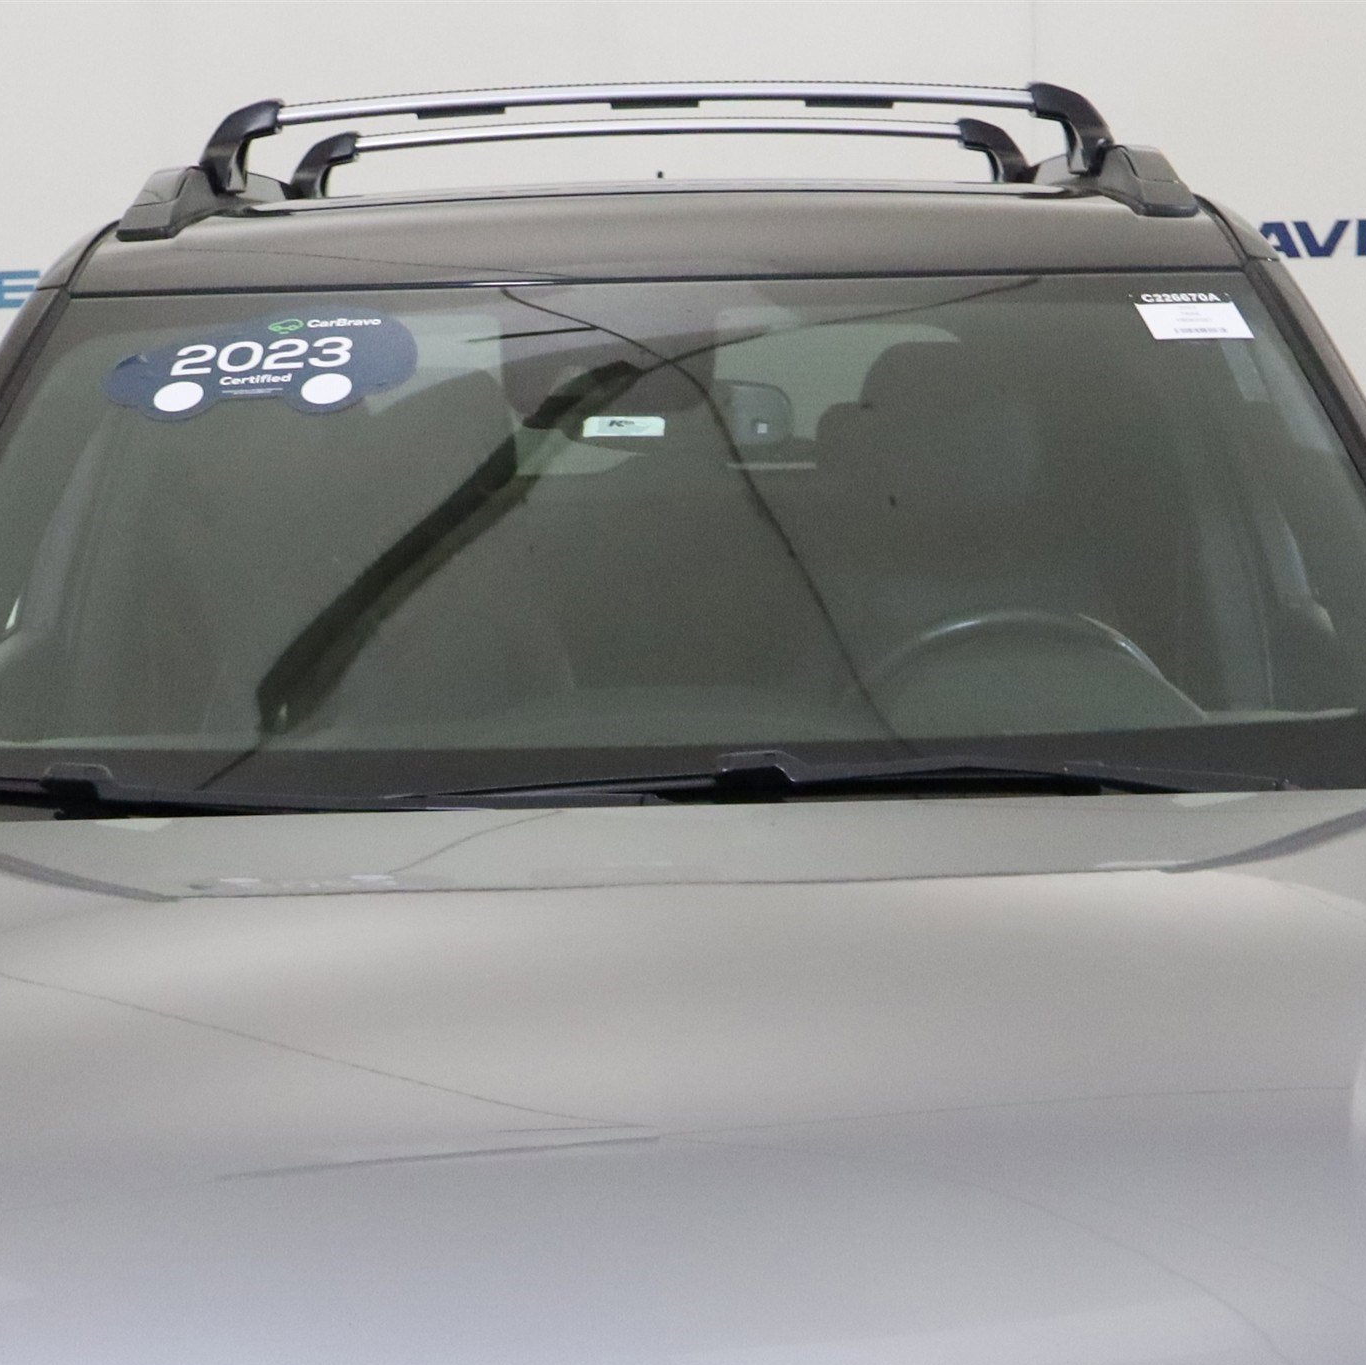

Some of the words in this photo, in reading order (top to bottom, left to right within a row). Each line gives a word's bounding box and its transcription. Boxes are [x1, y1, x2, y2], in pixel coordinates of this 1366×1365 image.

[306, 318, 382, 329] CarBravo
[170, 336, 354, 377] 2023
[218, 373, 294, 387] Certified
